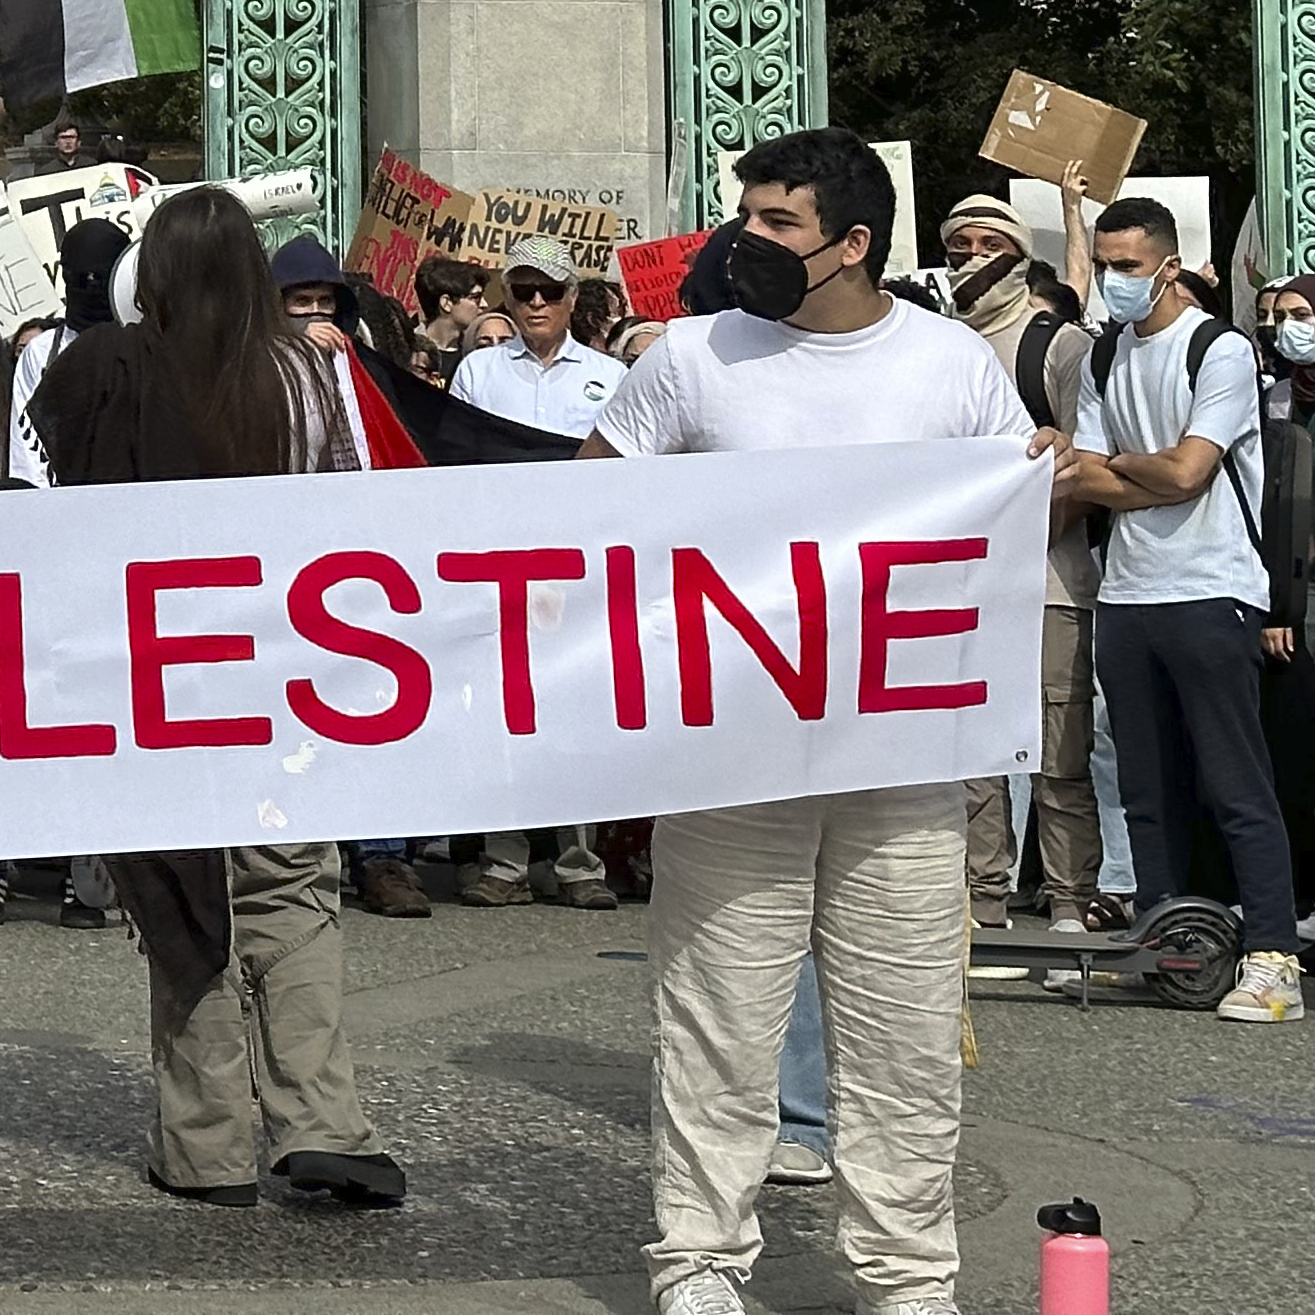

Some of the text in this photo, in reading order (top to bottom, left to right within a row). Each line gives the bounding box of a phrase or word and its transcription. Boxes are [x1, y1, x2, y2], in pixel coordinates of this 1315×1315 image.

[507, 187, 625, 205] MORY OF
[483, 192, 610, 242] YOU WILL
